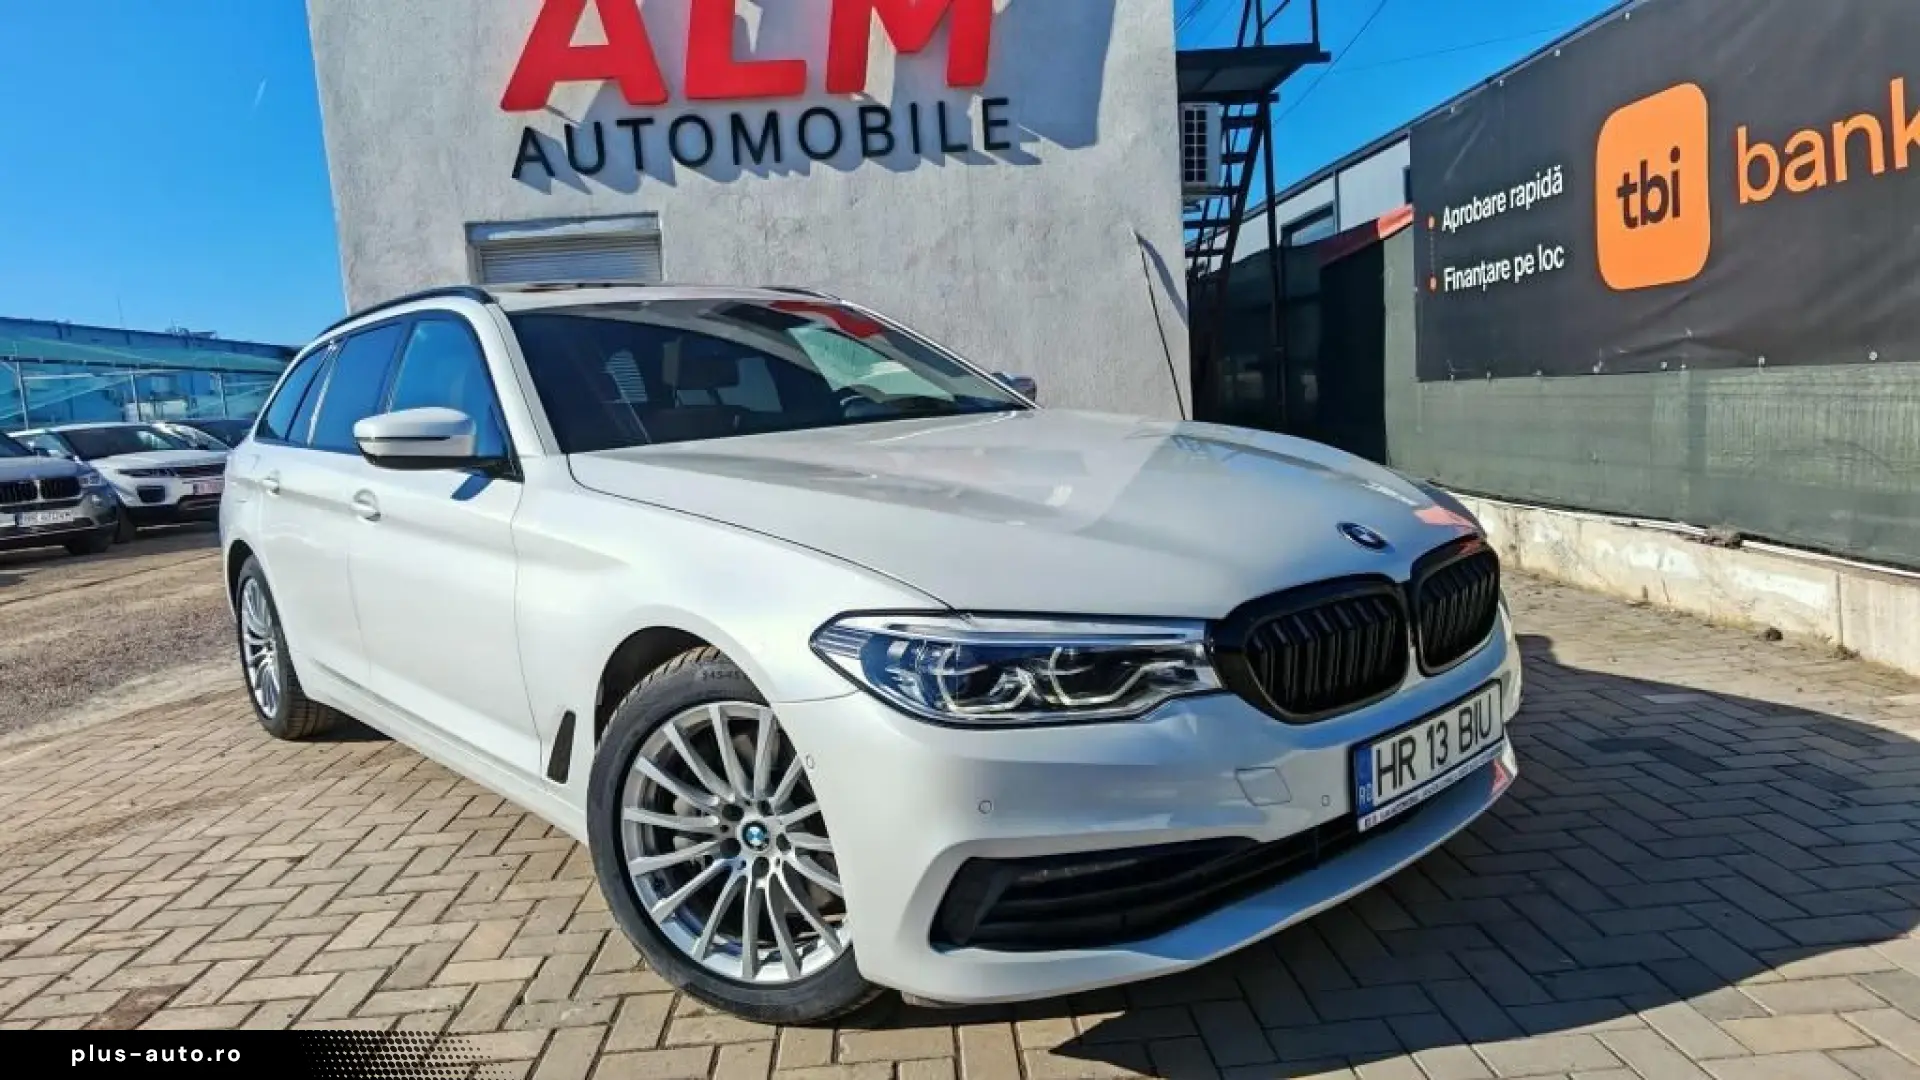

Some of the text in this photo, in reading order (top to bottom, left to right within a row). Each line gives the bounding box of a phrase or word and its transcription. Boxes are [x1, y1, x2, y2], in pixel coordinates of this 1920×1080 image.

[501, 0, 993, 111] ALM
[512, 97, 1012, 179] AUTOMOBILE
[1442, 164, 1563, 233] Aprobare rapidă
[1616, 146, 1681, 229] tbi
[1443, 244, 1565, 291] Finanțare pe loc
[1376, 735, 1416, 797] HR
[1427, 720, 1449, 770] 13
[1459, 693, 1492, 753] BIU
